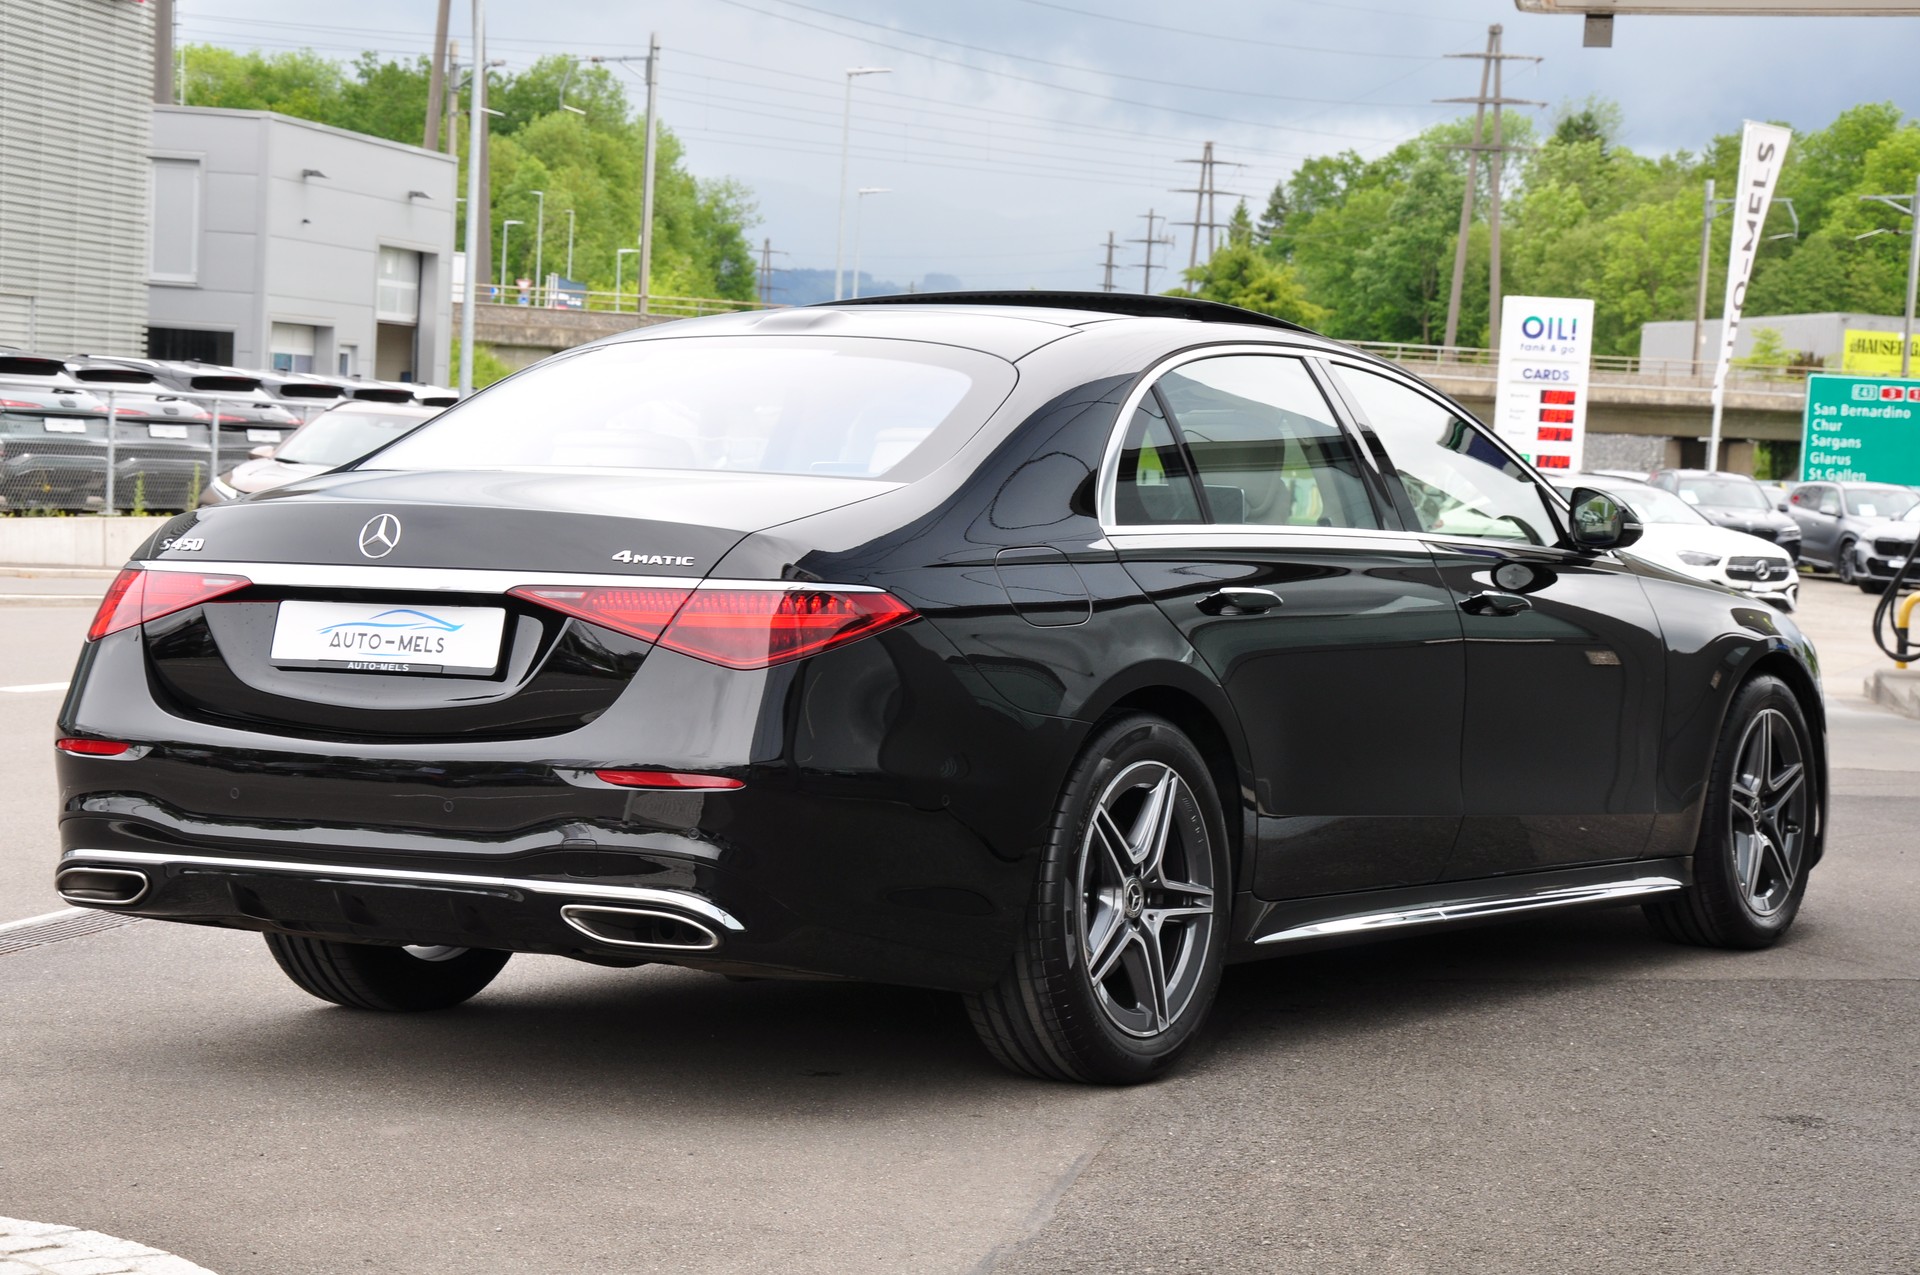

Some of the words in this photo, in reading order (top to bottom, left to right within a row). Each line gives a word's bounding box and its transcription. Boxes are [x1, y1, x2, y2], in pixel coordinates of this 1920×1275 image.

[1521, 315, 1577, 341] OIL!
[1520, 343, 1545, 352] tank
[1561, 347, 1575, 356] go
[1522, 368, 1570, 381] CARDS
[1813, 402, 1838, 416] San
[1840, 403, 1912, 419] Bernardino
[1811, 418, 1843, 432] Chur
[1811, 433, 1862, 451] Sargans
[1809, 451, 1852, 466] Glarus
[611, 550, 696, 566] 4MATIC
[329, 631, 445, 654] AUTO-MELS
[347, 661, 410, 672] AUTO-MELS
